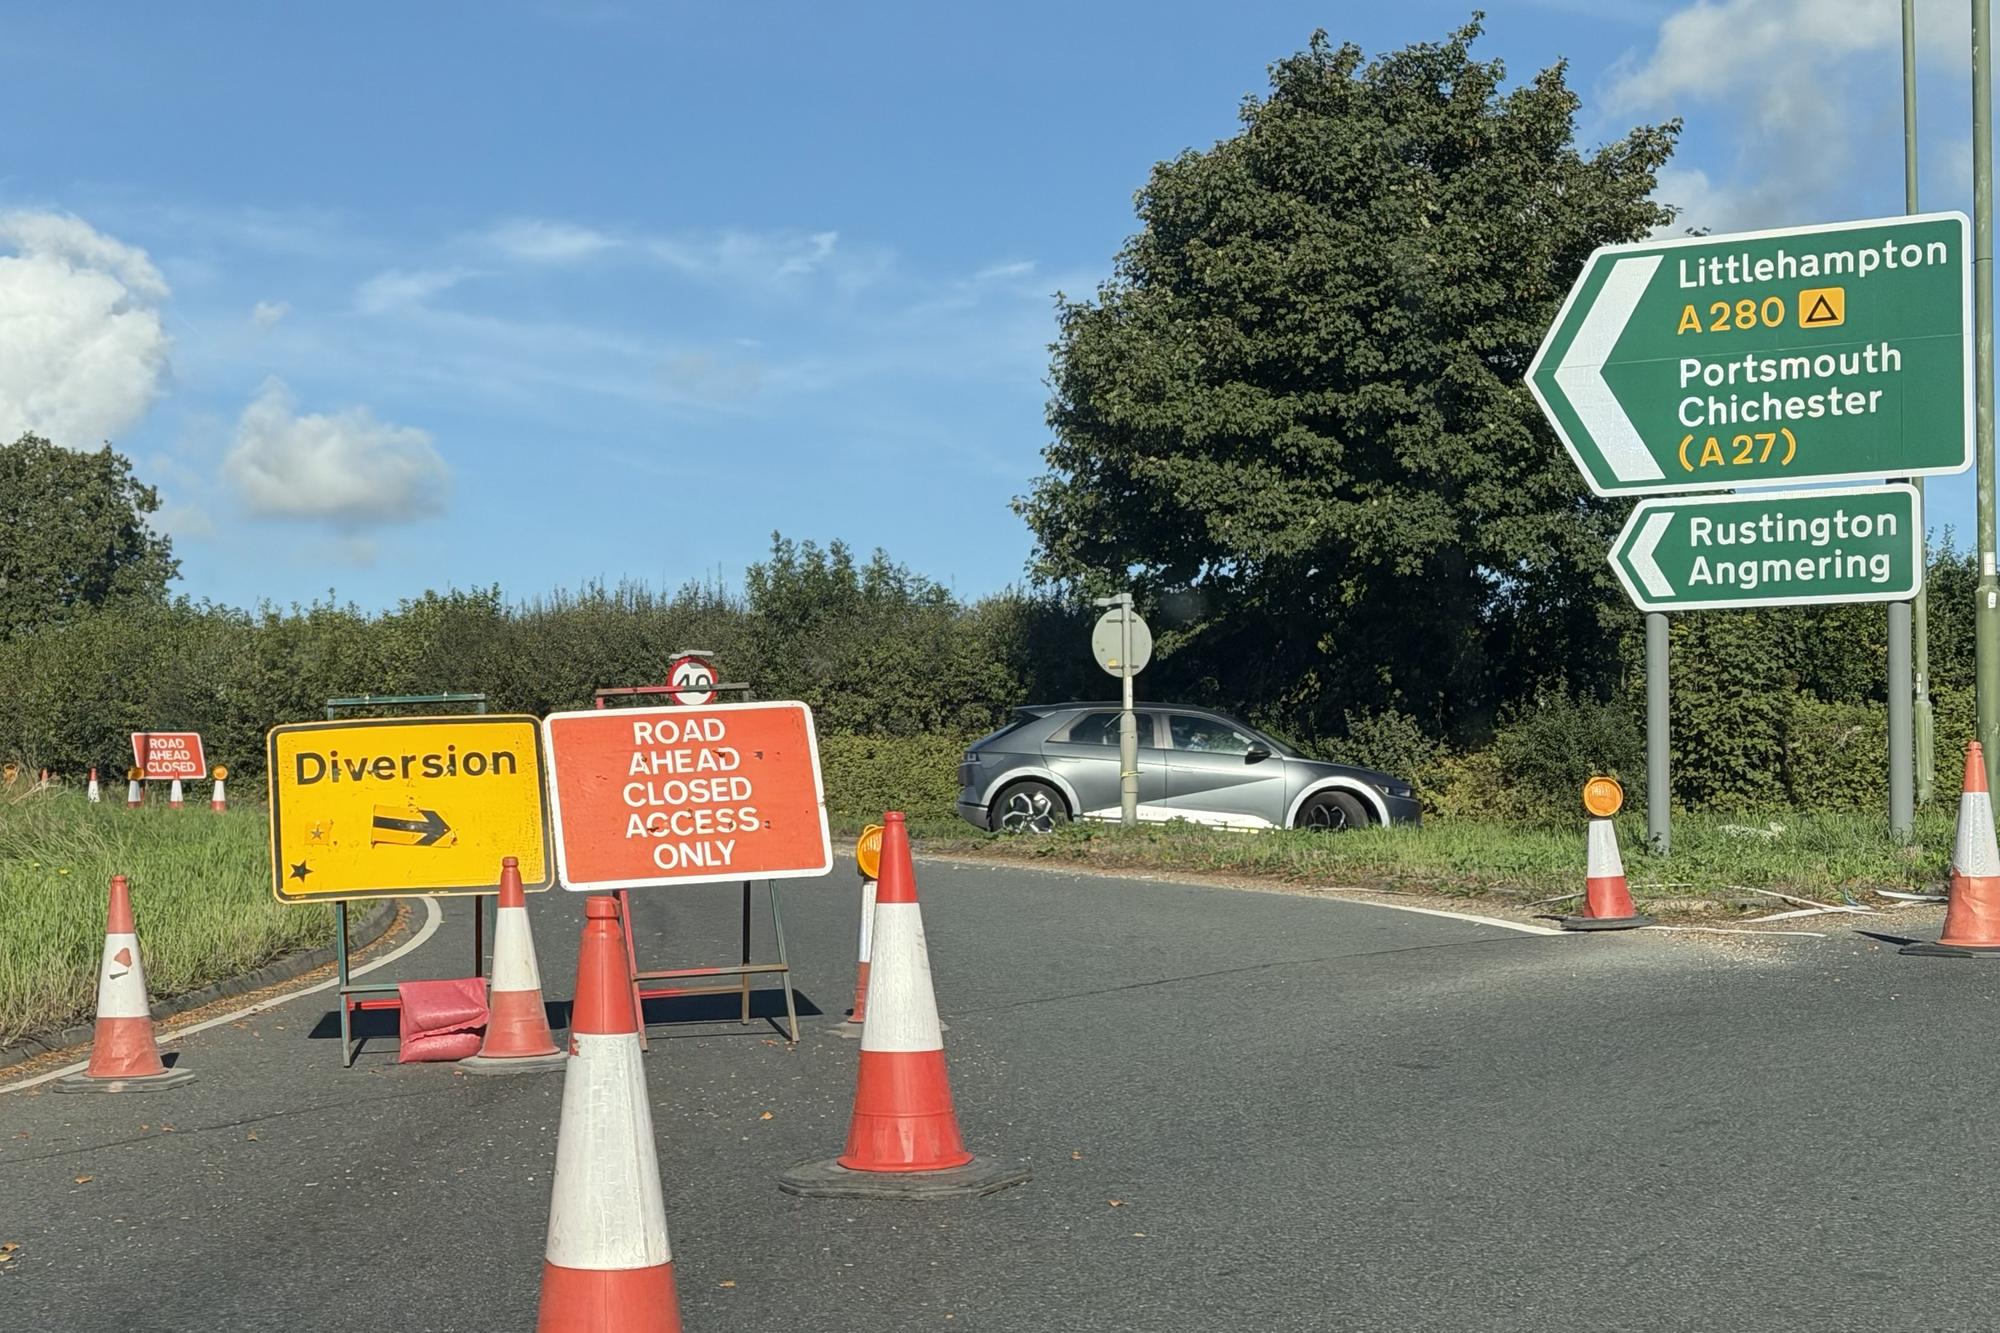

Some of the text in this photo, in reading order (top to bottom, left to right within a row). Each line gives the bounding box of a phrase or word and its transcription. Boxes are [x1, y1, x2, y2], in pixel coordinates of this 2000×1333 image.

[1679, 239, 1947, 289] Littlehampton
[1680, 342, 1901, 389] Portsmouth
[1678, 386, 1883, 428] Chichester
[1690, 509, 1898, 547] Rustington
[1688, 549, 1891, 588] Angmering
[676, 673, 712, 695] 40
[149, 738, 185, 749] ROAD
[634, 718, 726, 745] ROAD
[146, 761, 196, 773] CLOSED
[149, 750, 191, 761] AHEAD
[296, 744, 517, 785] Diversion
[628, 747, 741, 777] AHEAD
[622, 777, 753, 808] CLOSED
[625, 806, 761, 839] ACCESS
[653, 839, 736, 870] ONLY
